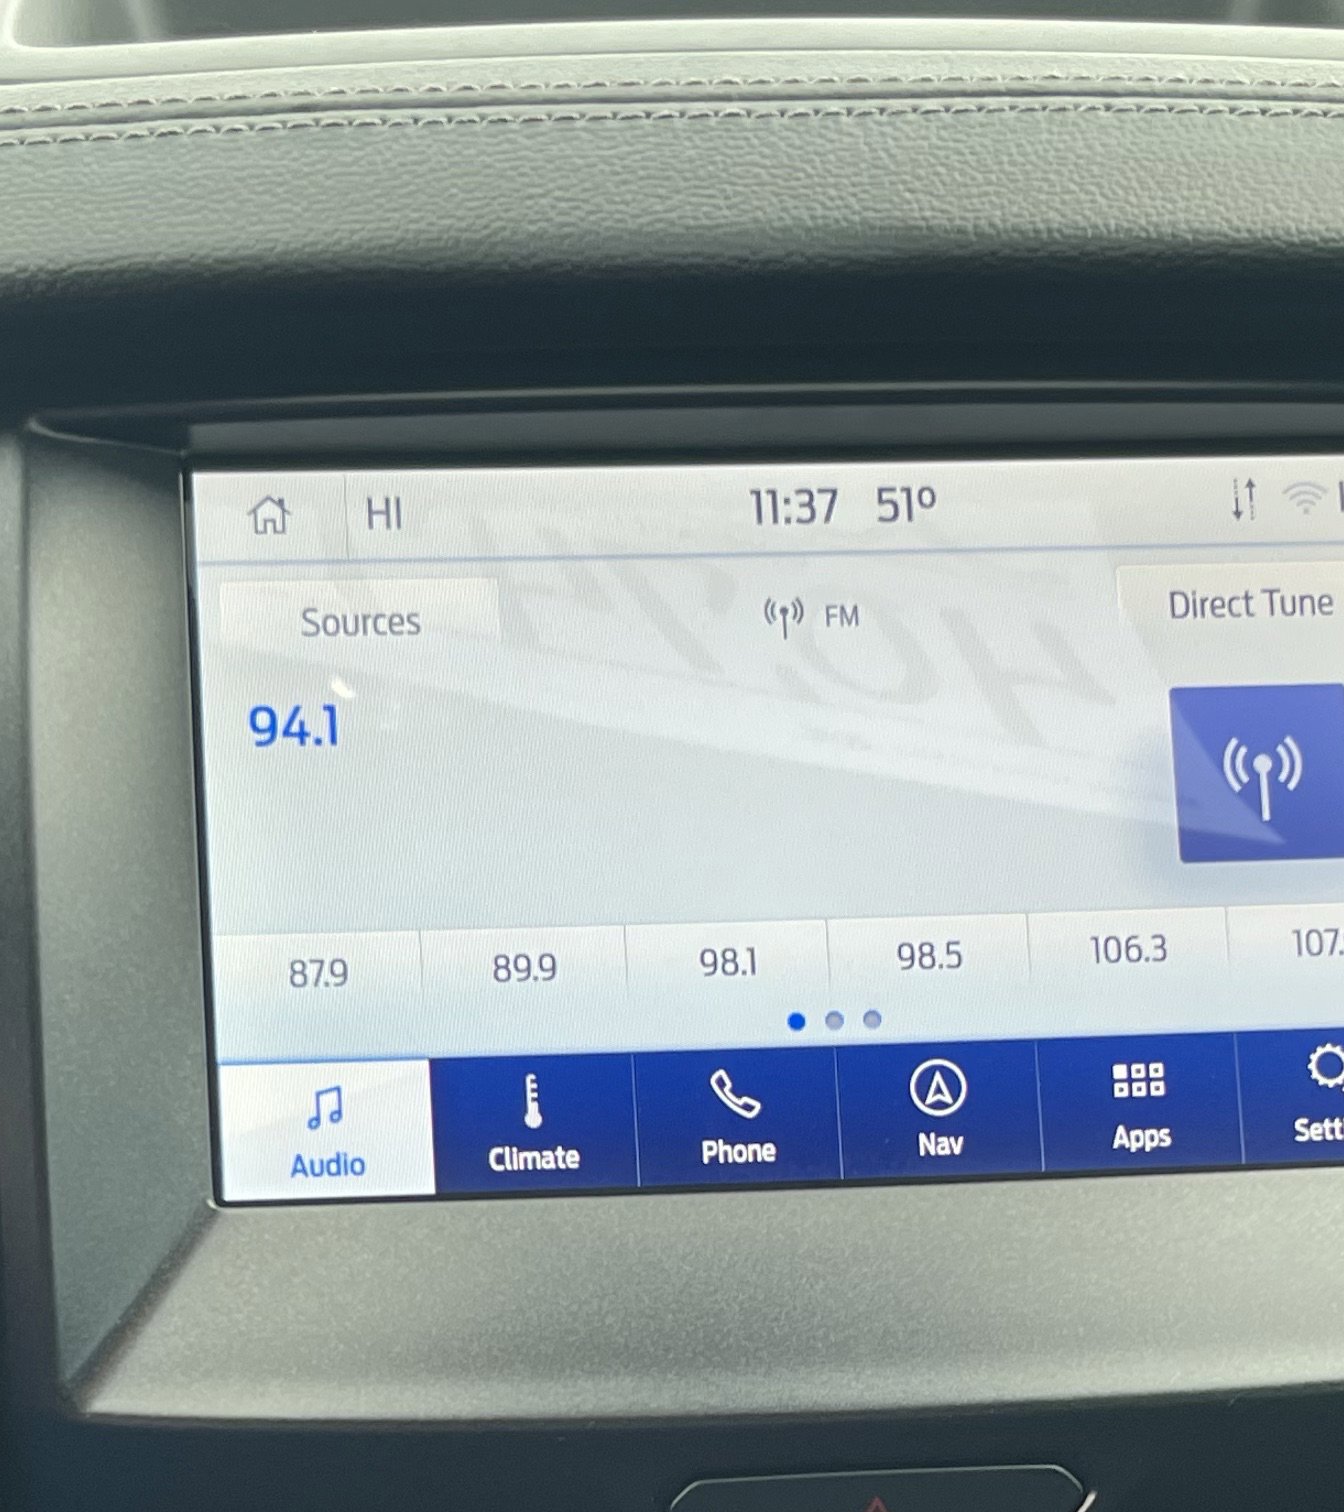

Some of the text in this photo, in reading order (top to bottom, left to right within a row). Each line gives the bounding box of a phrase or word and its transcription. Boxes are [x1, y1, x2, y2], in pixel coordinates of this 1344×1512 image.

[365, 496, 403, 531] HI
[749, 488, 840, 526] 11:37
[824, 605, 860, 628] FM
[1168, 587, 1335, 620] Direct Tune
[300, 606, 422, 638] Sources
[248, 703, 339, 748] 94.1
[699, 947, 759, 978] 98.1
[896, 940, 964, 971] 98.5
[1090, 934, 1169, 965] 106.3
[289, 958, 350, 989] 87.9
[492, 952, 558, 983] 89.9
[701, 1139, 777, 1166] Phone
[917, 1131, 965, 1158] Nav
[1112, 1124, 1173, 1154] Apps
[290, 1151, 367, 1179] Audio
[487, 1145, 581, 1173] Climate
